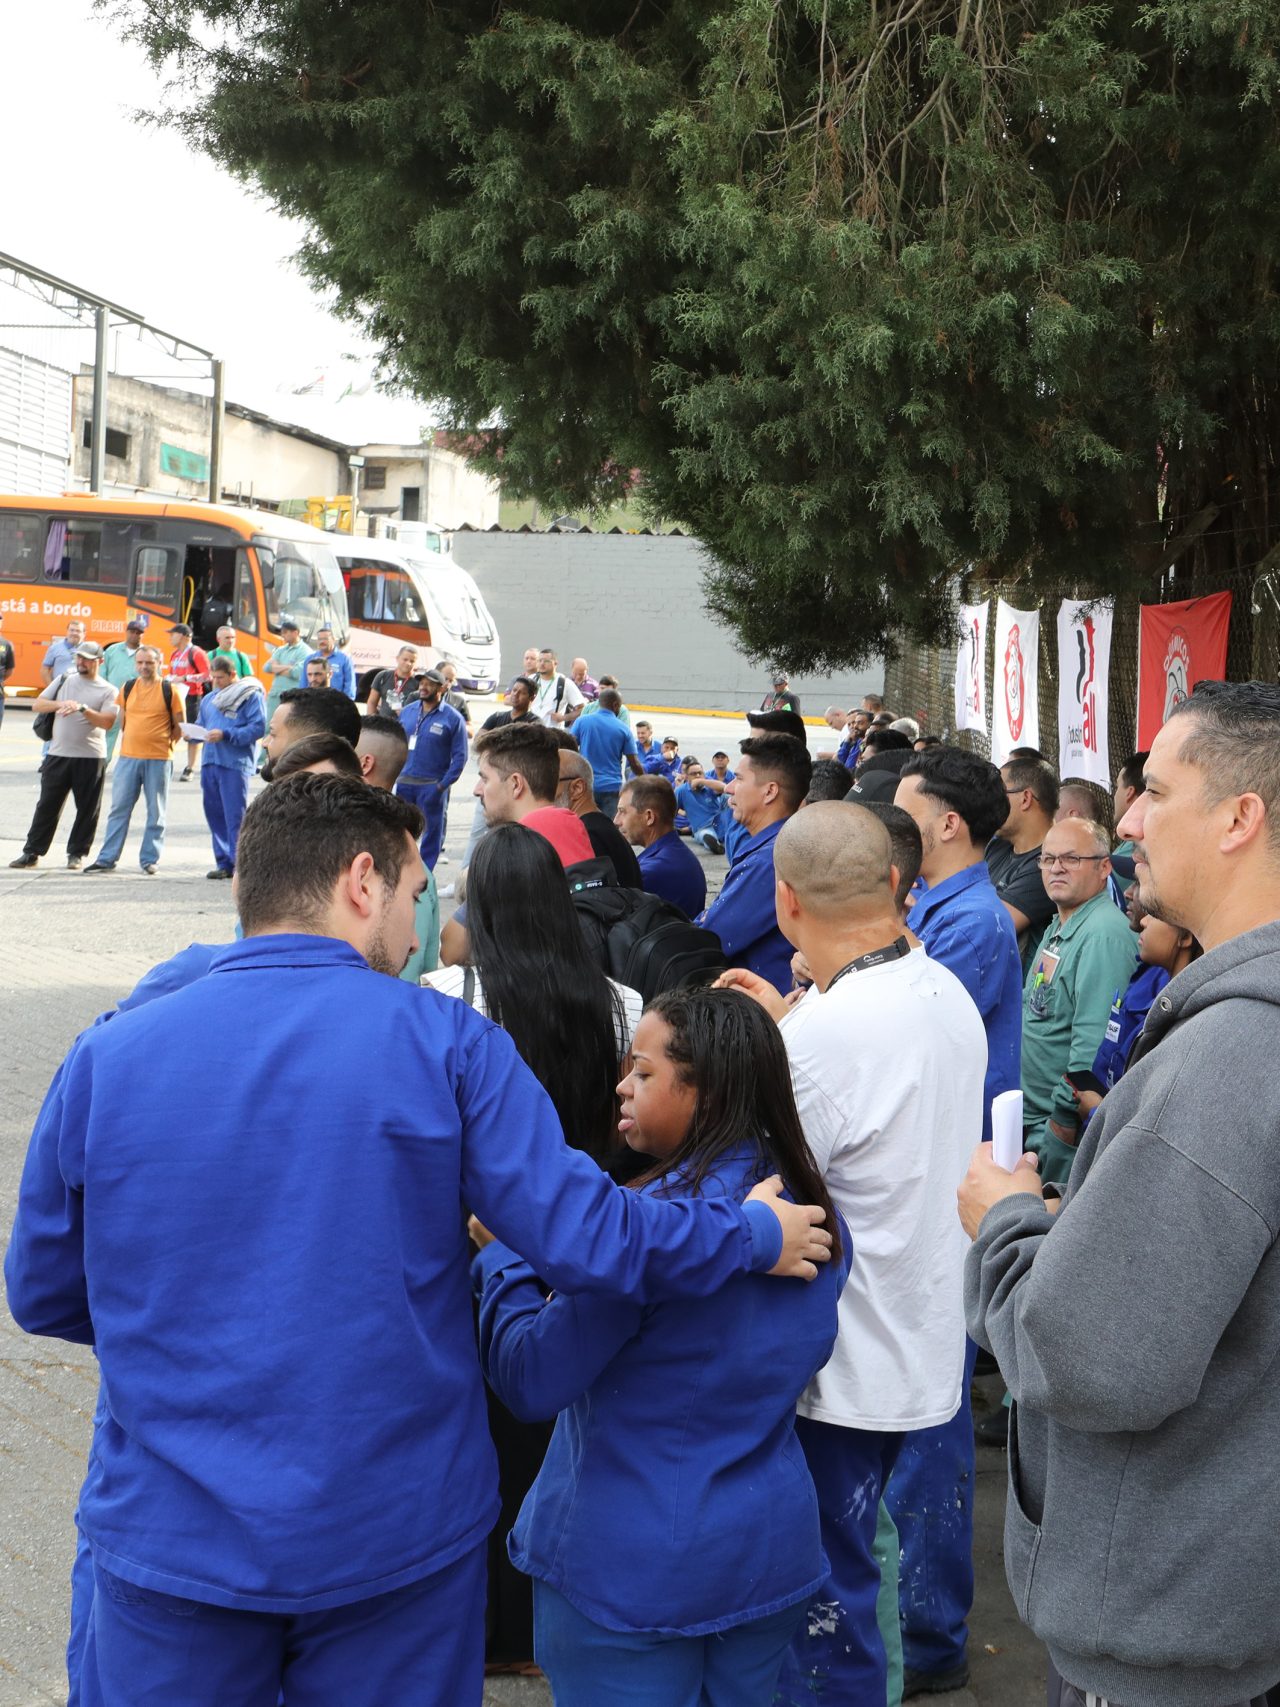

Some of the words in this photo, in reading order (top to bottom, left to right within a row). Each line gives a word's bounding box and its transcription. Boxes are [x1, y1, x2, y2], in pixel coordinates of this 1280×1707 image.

[0, 598, 26, 613] stá
[30, 602, 39, 614] a
[43, 600, 92, 617] bordo
